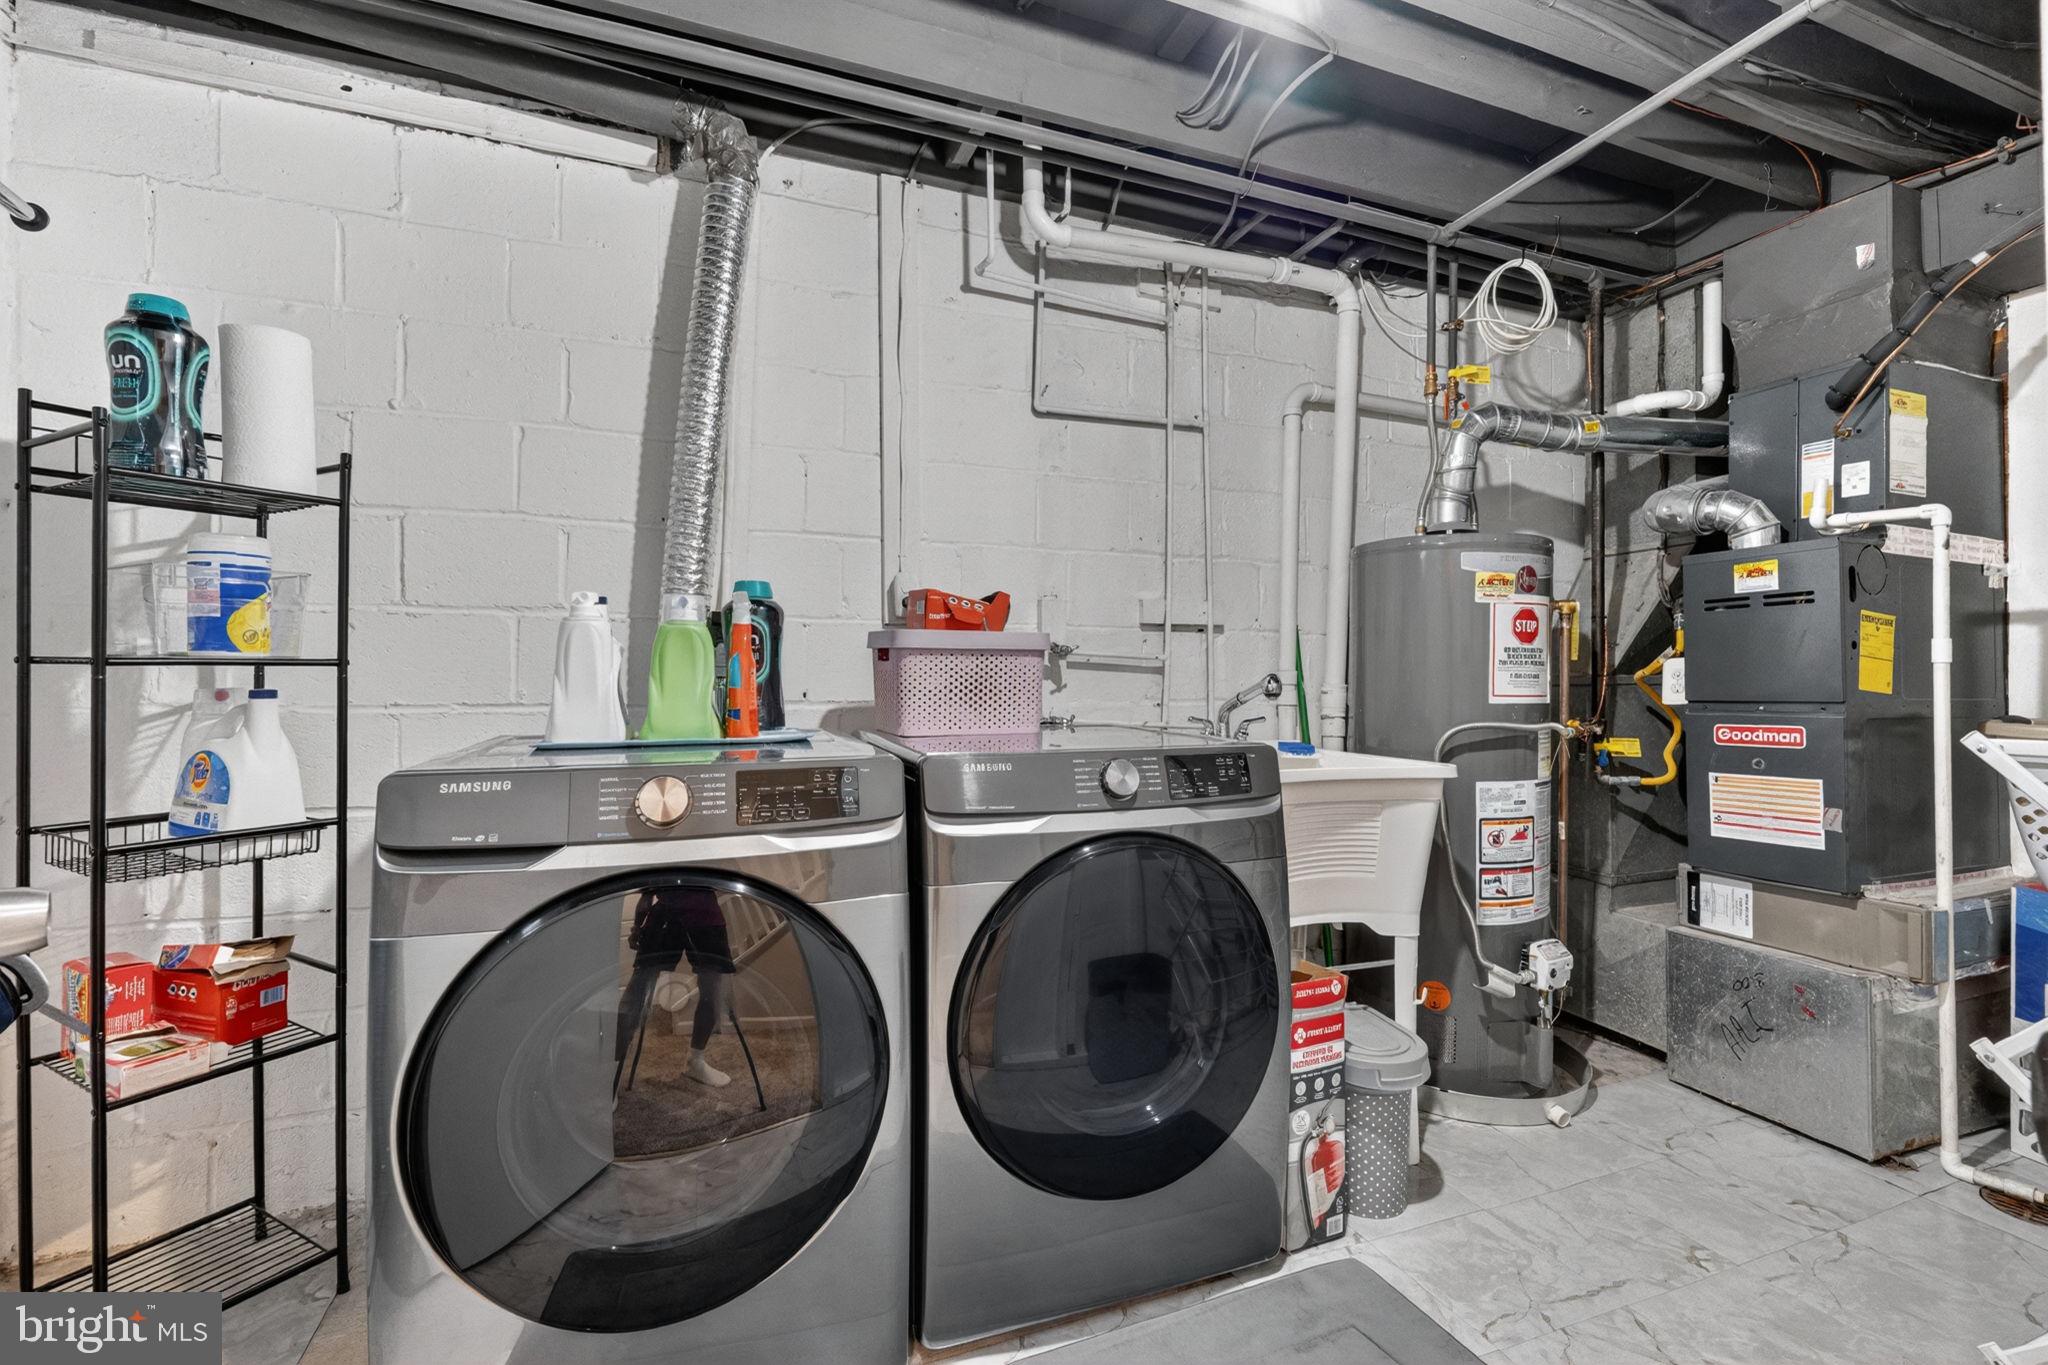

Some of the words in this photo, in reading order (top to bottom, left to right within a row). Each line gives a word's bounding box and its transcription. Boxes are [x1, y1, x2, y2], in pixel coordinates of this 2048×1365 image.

[111, 354, 141, 368] un
[1515, 619, 1537, 632] STOP
[1717, 727, 1801, 744] Goodman
[963, 762, 1013, 772] SAMSUNG
[439, 780, 512, 794] SAMSUNG
